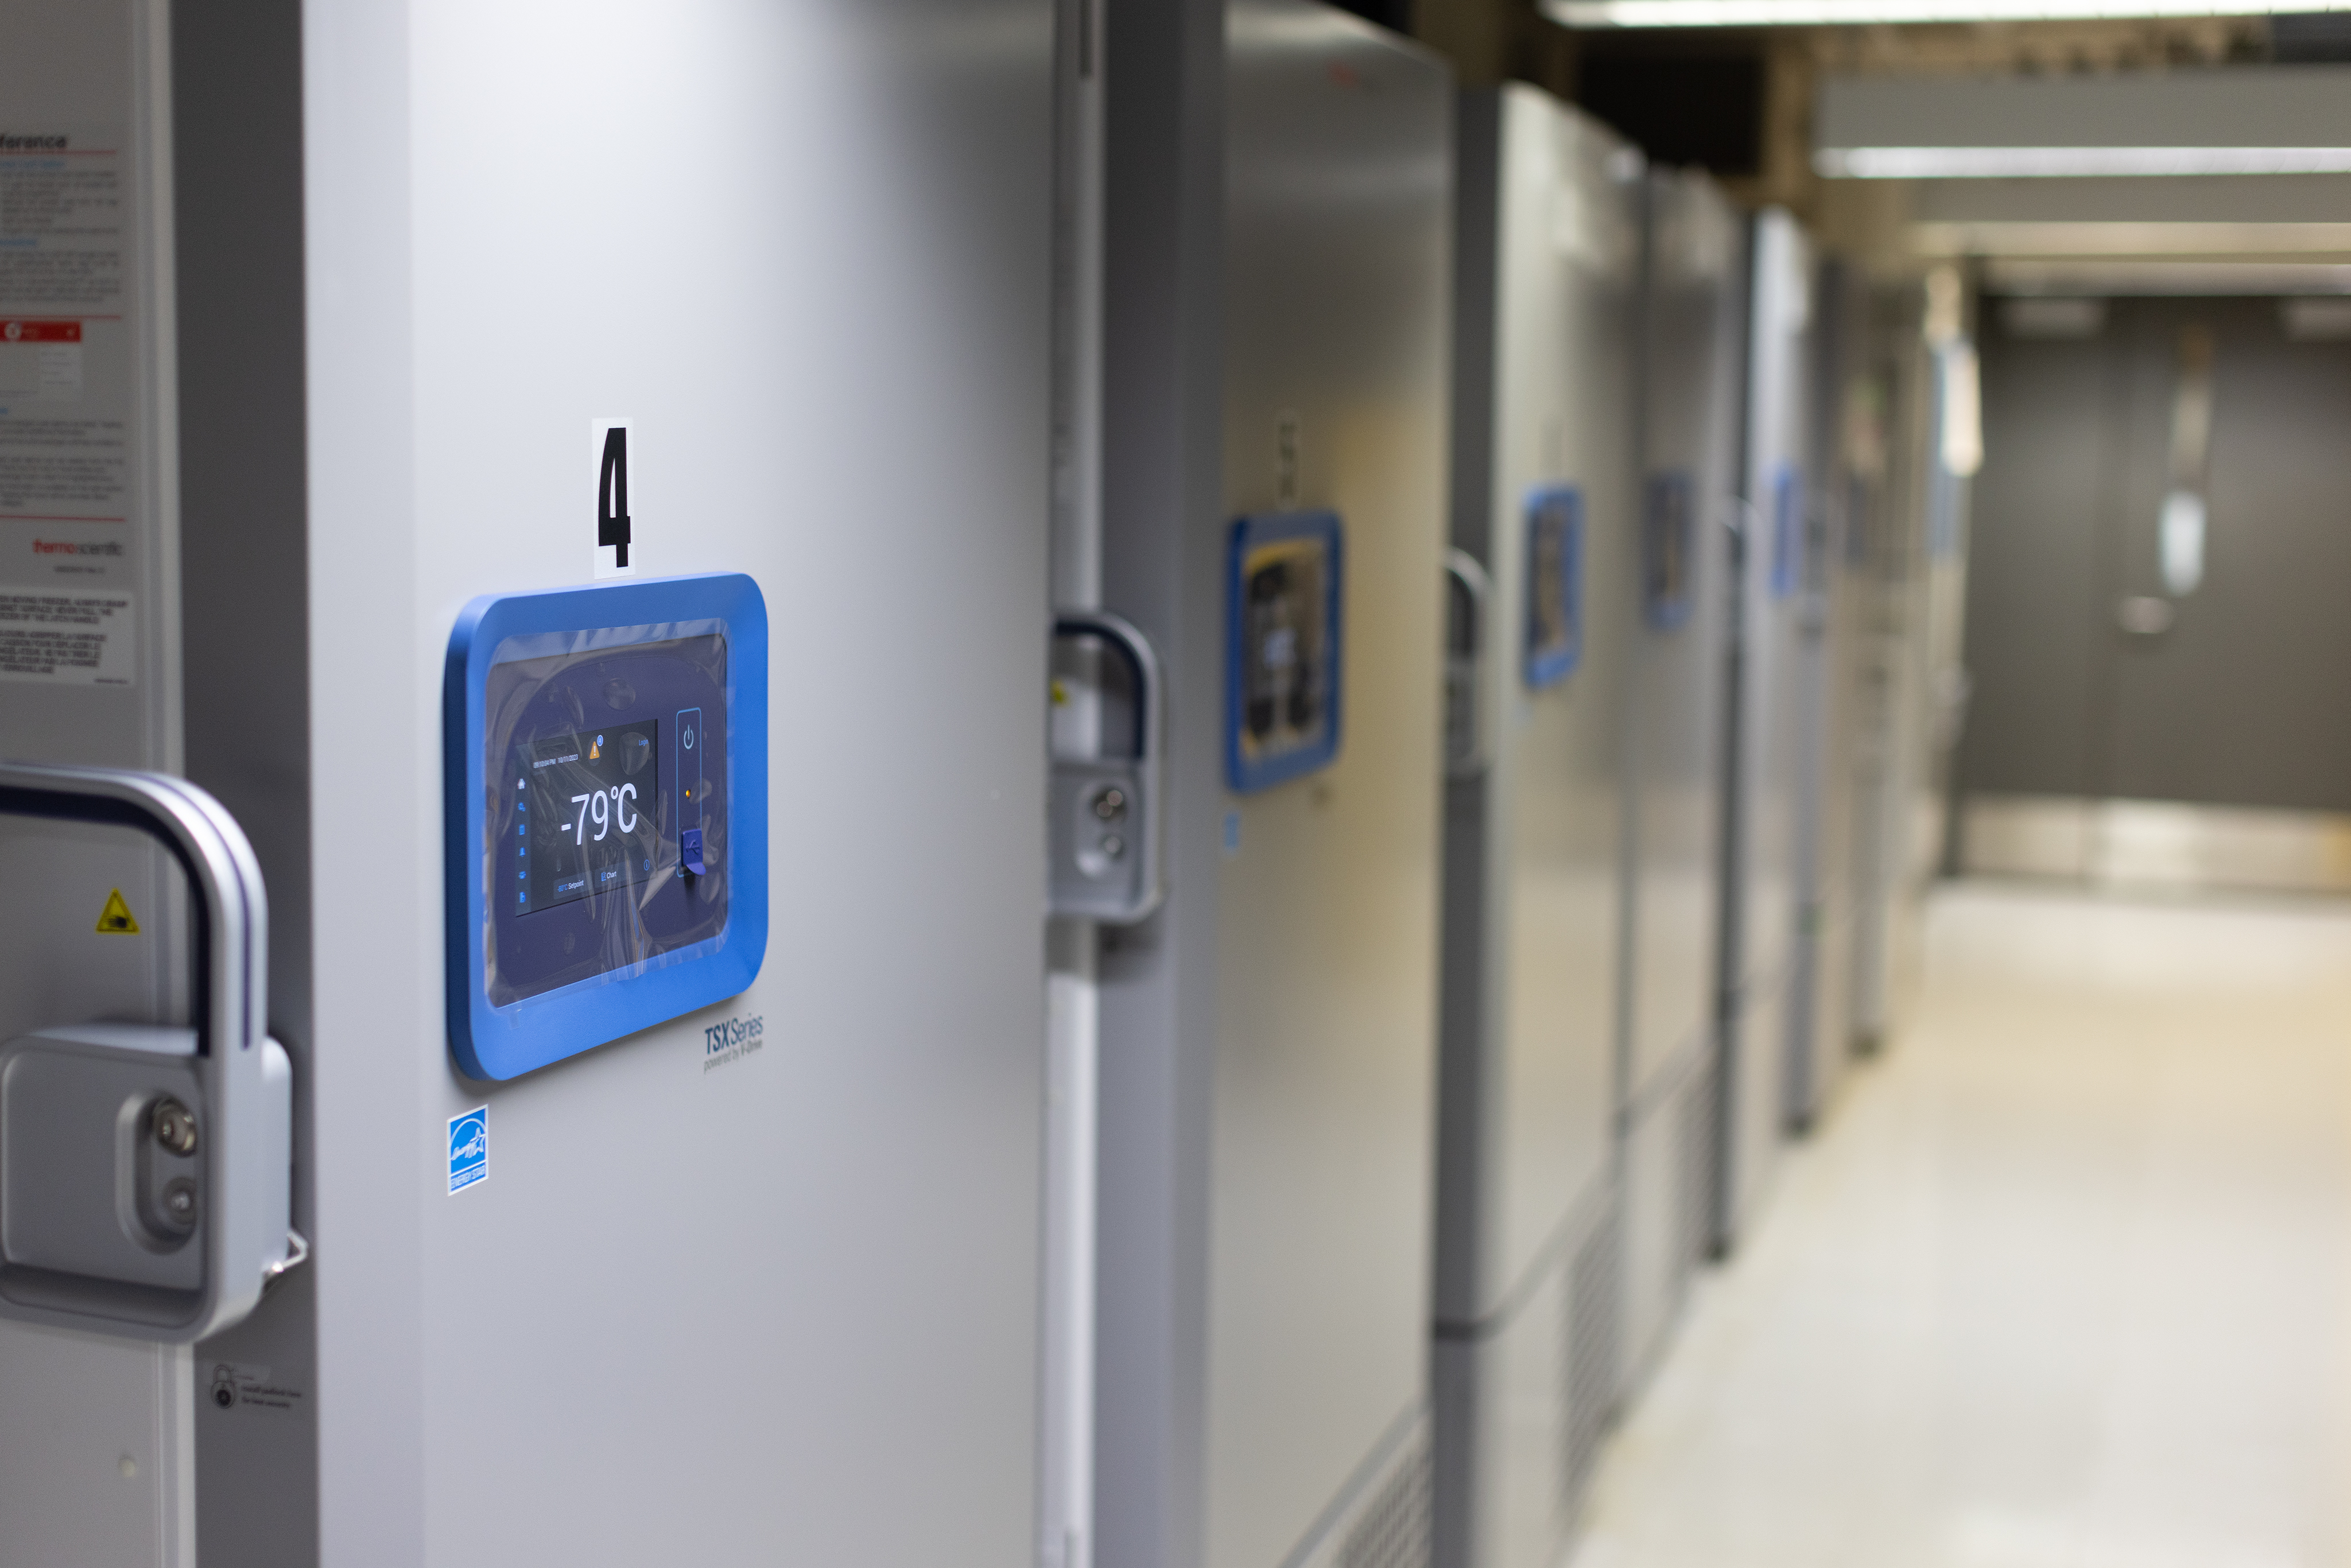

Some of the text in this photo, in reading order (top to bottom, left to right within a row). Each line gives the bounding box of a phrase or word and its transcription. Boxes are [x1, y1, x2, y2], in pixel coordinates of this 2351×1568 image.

[599, 428, 631, 568] 4
[639, 738, 649, 747] Login
[558, 754, 579, 763] 10/11/2023
[561, 783, 637, 846] -79°C
[568, 879, 584, 890] Setpoint
[705, 1012, 763, 1055] TSX Series
